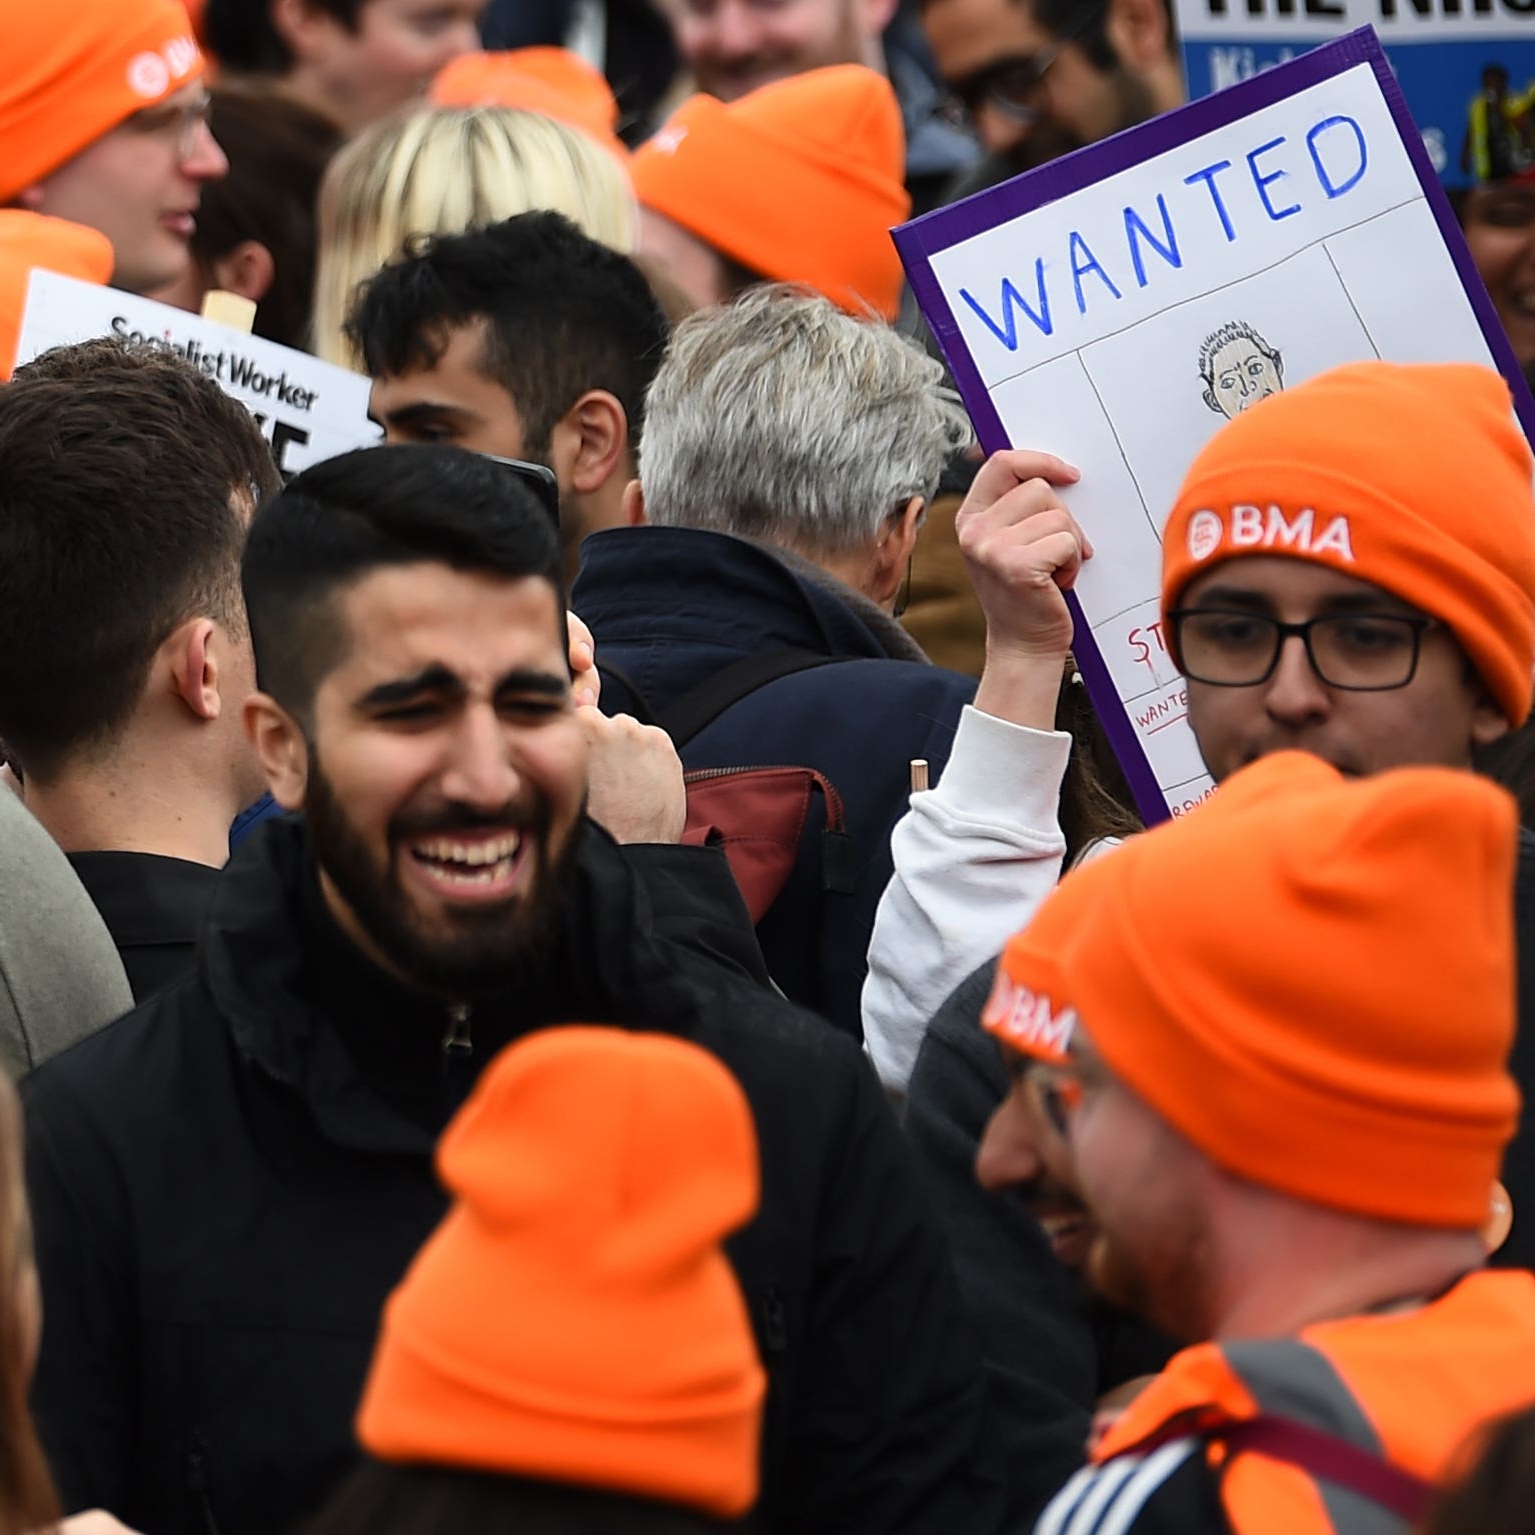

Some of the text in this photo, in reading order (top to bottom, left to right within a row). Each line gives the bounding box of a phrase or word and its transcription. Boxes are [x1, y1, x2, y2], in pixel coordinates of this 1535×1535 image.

[958, 113, 1368, 351] WANTED
[230, 353, 319, 412] Worker
[1232, 505, 1355, 565] BMA
